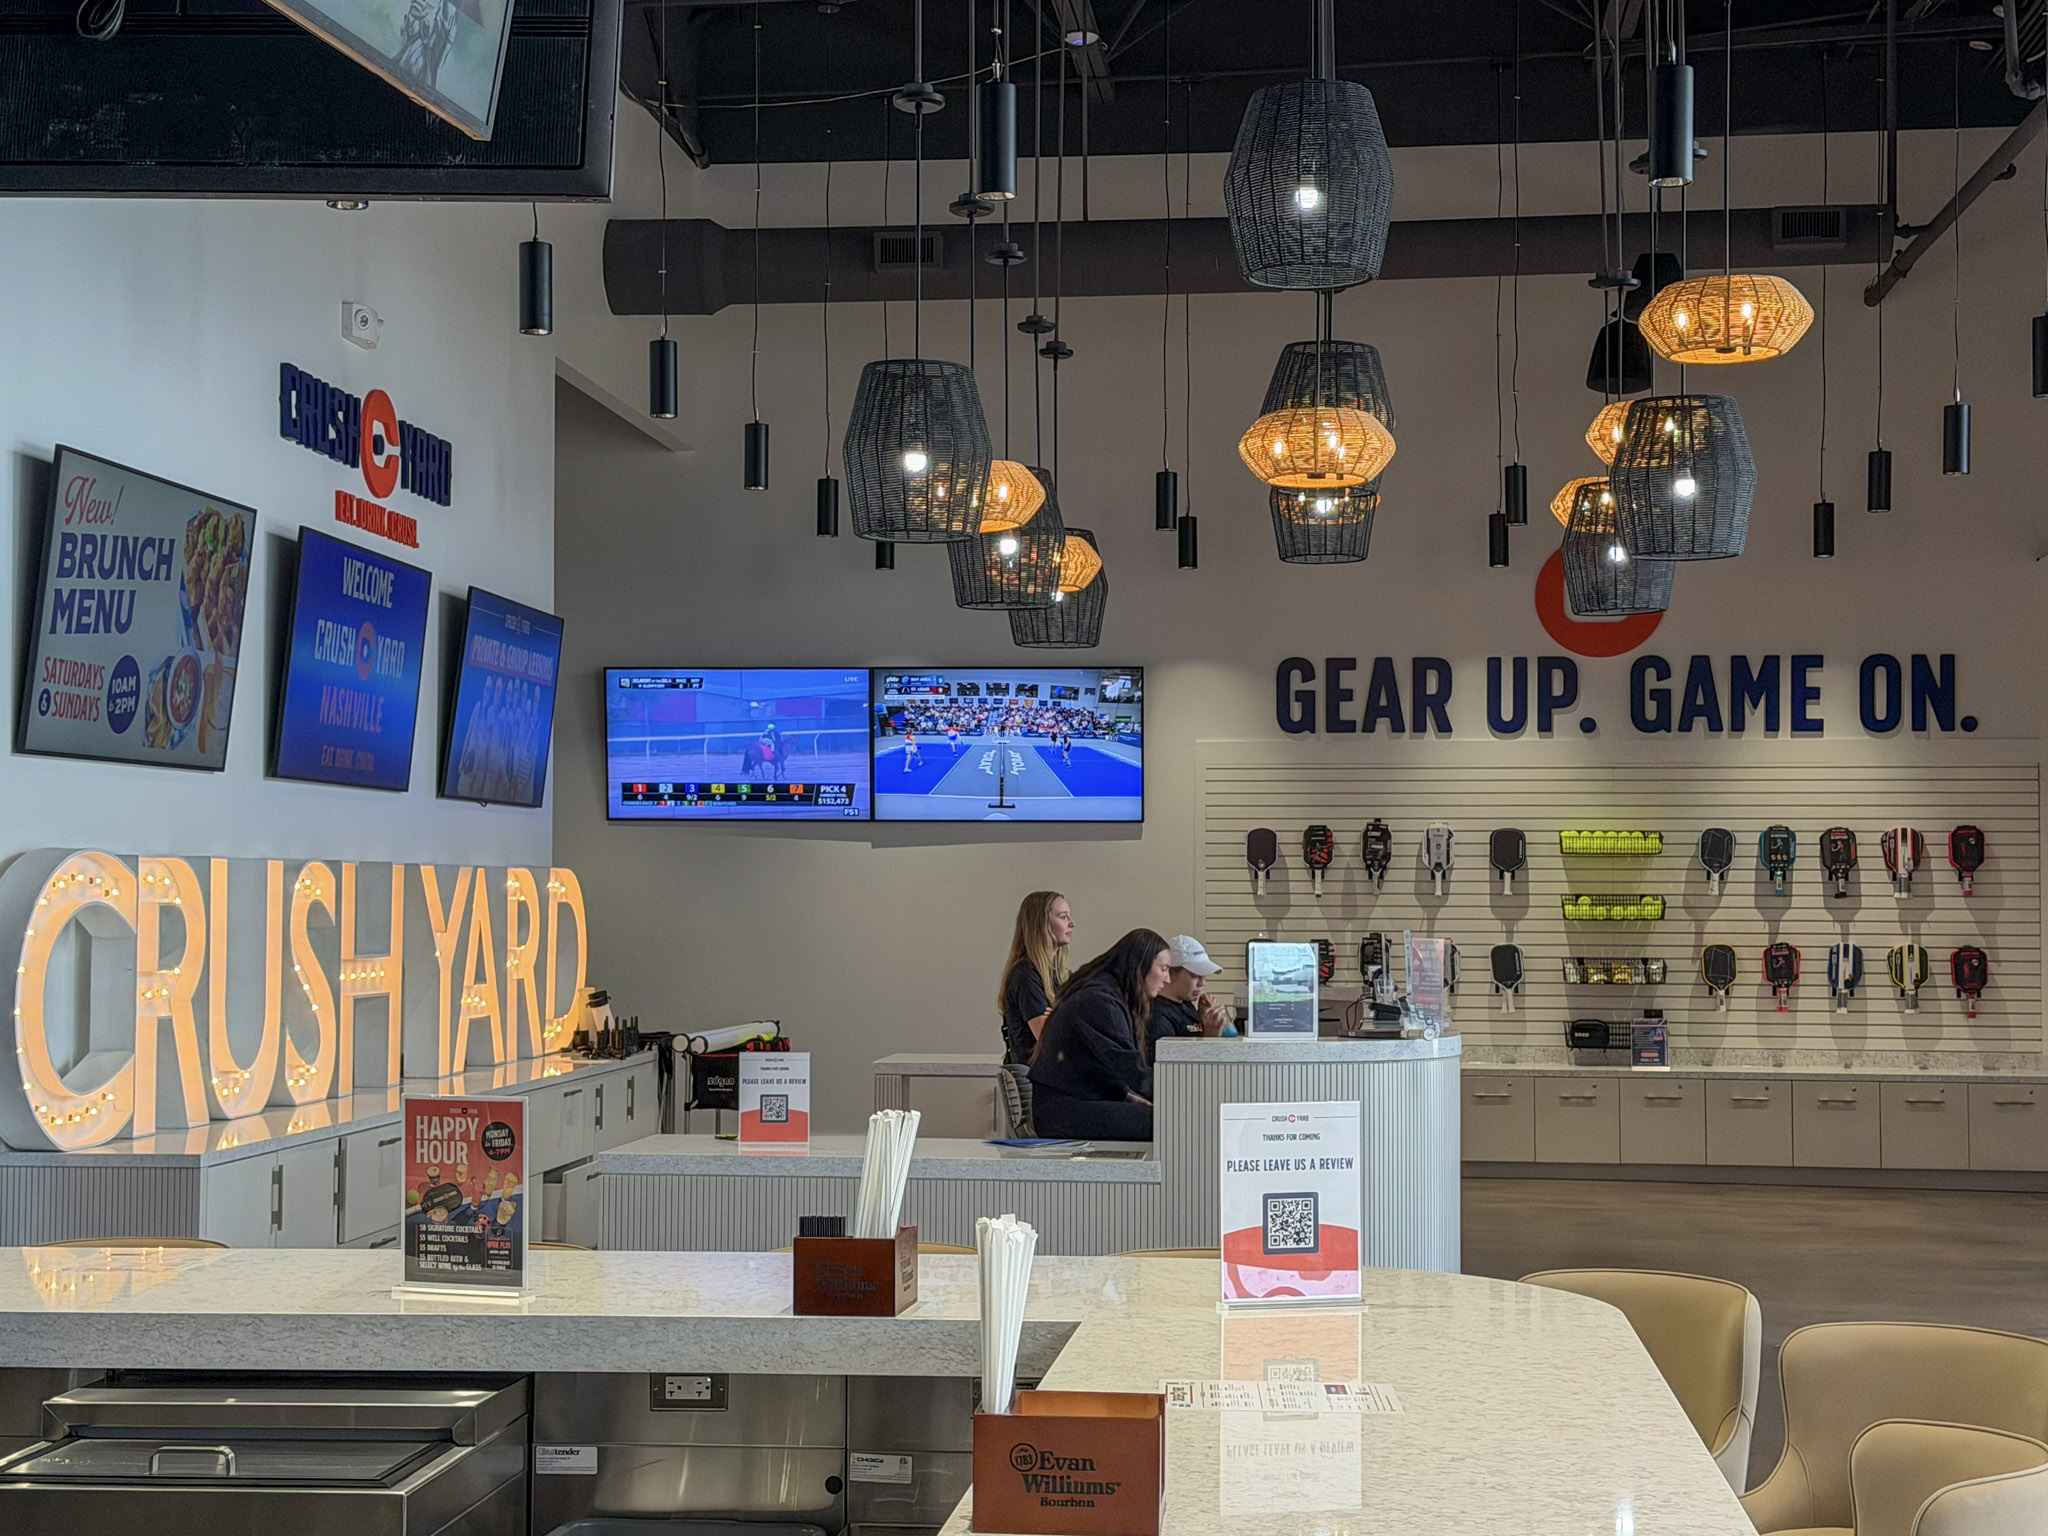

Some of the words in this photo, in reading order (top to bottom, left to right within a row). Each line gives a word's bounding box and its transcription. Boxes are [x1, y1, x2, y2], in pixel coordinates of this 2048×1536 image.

[279, 362, 361, 468] CRUSH
[398, 420, 452, 507] YARD
[65, 476, 124, 525] New!
[56, 532, 176, 581] BRUNCH
[342, 556, 395, 609] WELCOME
[49, 588, 137, 634] MENU
[314, 619, 357, 667] CRUSH
[376, 635, 405, 678] YARD
[42, 656, 106, 691] SATURDAYS
[112, 675, 137, 695] 10AM
[1275, 656, 1453, 734] GEAR
[1486, 655, 1598, 735] UP.
[1630, 654, 1824, 734] GAME
[1858, 653, 1979, 735] ON.
[40, 693, 48, 711] &
[51, 691, 101, 722] SUNDAYS
[114, 696, 136, 714] 2PM
[320, 685, 384, 733] NASHVILLE
[637, 784, 642, 792] 1
[689, 784, 695, 792] 3
[715, 784, 721, 792] 4
[741, 784, 748, 793] 5
[766, 784, 774, 793] 6
[794, 784, 800, 793] 7
[820, 785, 840, 793] PICK
[840, 785, 847, 793] 4
[0, 848, 404, 1153] CRUSH
[410, 862, 588, 1096] YARD
[416, 1115, 480, 1141] HAPPY
[1271, 1115, 1288, 1123] CRUSH
[485, 1128, 509, 1139] MONDAY
[492, 1138, 512, 1147] FRIDAY
[1262, 1133, 1285, 1142] THANKS
[1286, 1133, 1298, 1141] FOR
[1298, 1132, 1321, 1141] COMING
[416, 1140, 469, 1165] HOUR
[1227, 1159, 1261, 1172] PLEASE
[1263, 1159, 1291, 1172] LEAVE
[1294, 1158, 1307, 1171] US
[1309, 1158, 1316, 1171] A
[1319, 1157, 1354, 1170] REVIEW
[427, 1224, 455, 1233] SIGNATURE
[455, 1225, 483, 1234] COCKTAILS
[427, 1234, 441, 1242] WELL
[441, 1235, 469, 1243] COCKTAILS
[427, 1244, 447, 1252] DRAFTS
[427, 1254, 450, 1262] BOTTLED
[419, 1261, 437, 1269] SELECT
[438, 1262, 452, 1270] WINE
[466, 1263, 482, 1271] GLASS
[1015, 1454, 1033, 1466] 1783
[1038, 1450, 1096, 1472] Evan
[1021, 1473, 1117, 1495] Williams
[1040, 1496, 1095, 1508] Bourbon
